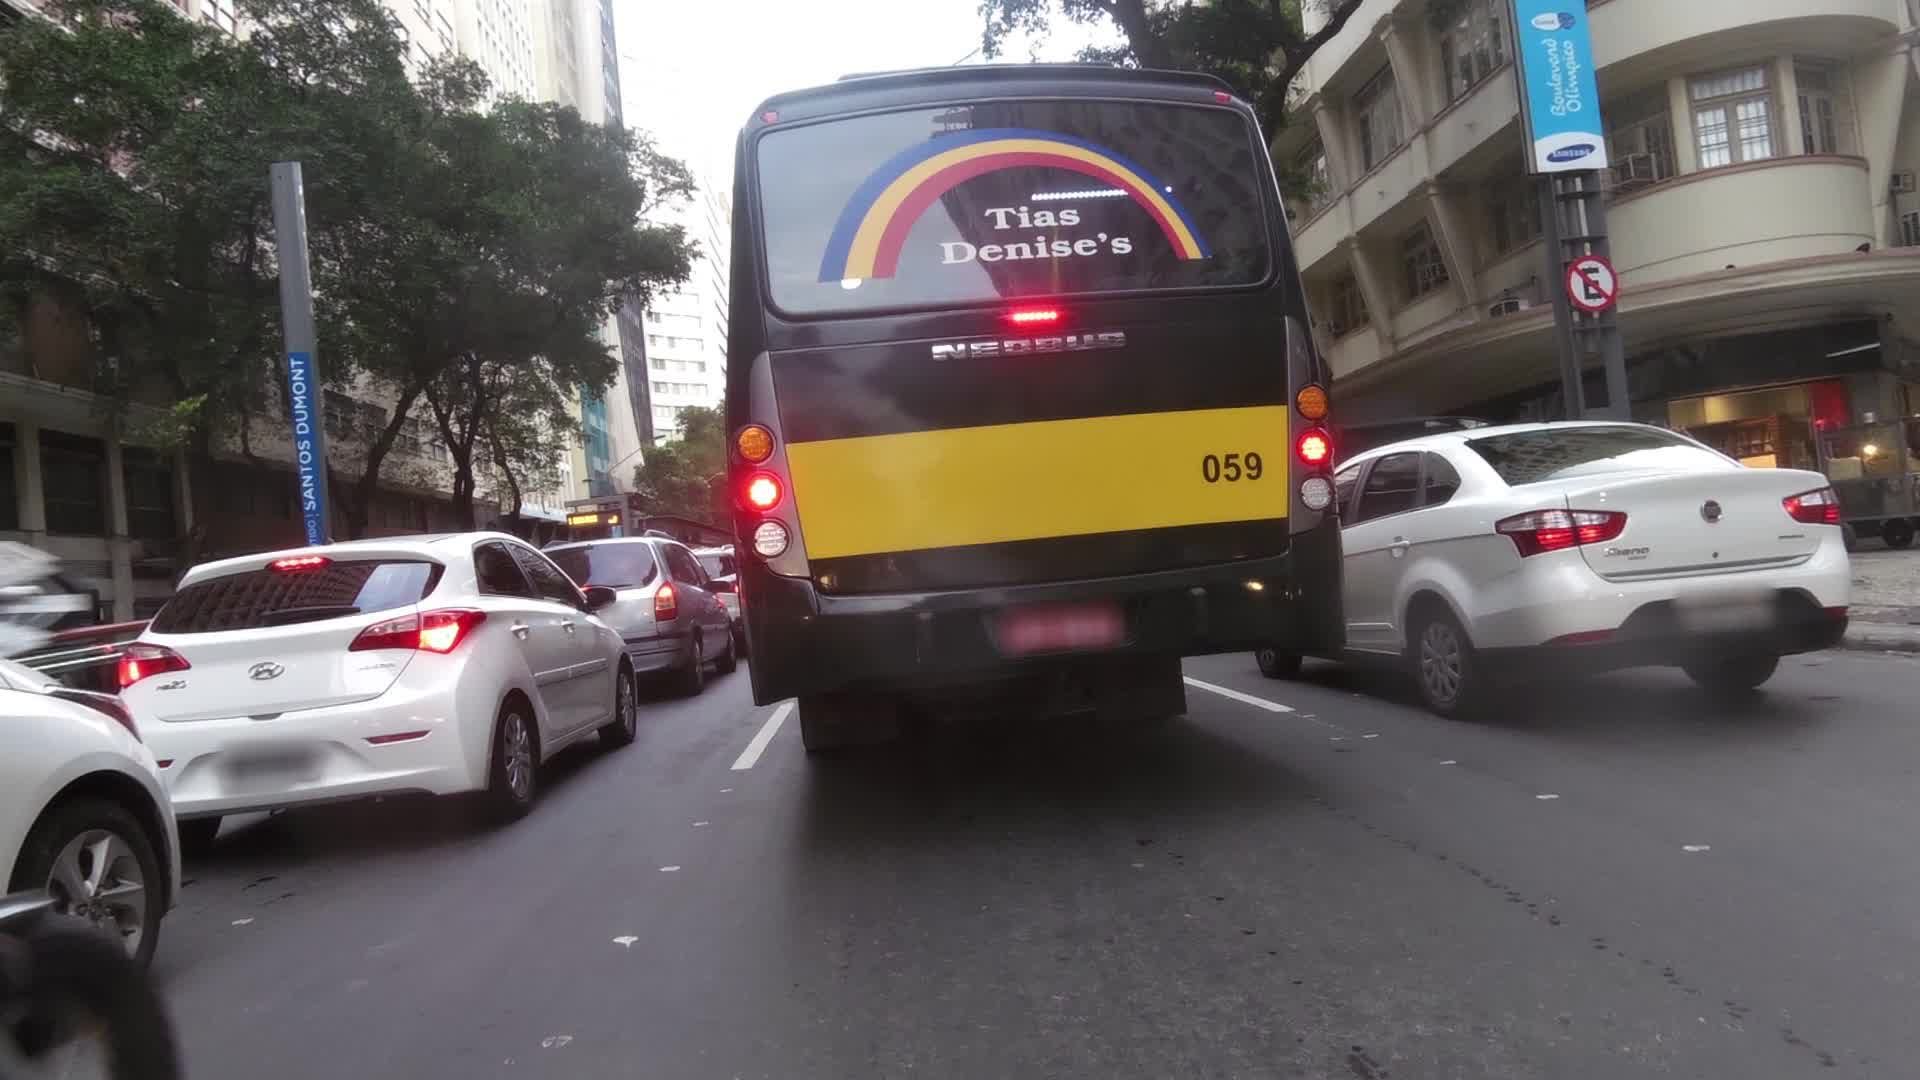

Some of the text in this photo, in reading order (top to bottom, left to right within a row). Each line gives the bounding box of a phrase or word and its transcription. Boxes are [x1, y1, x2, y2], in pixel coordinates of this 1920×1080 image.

[984, 205, 1081, 230] Tias
[931, 331, 1126, 361] NEOBUS
[290, 358, 310, 434] DUMONT
[299, 439, 317, 511] SANTOS
[1202, 451, 1263, 483] 059
